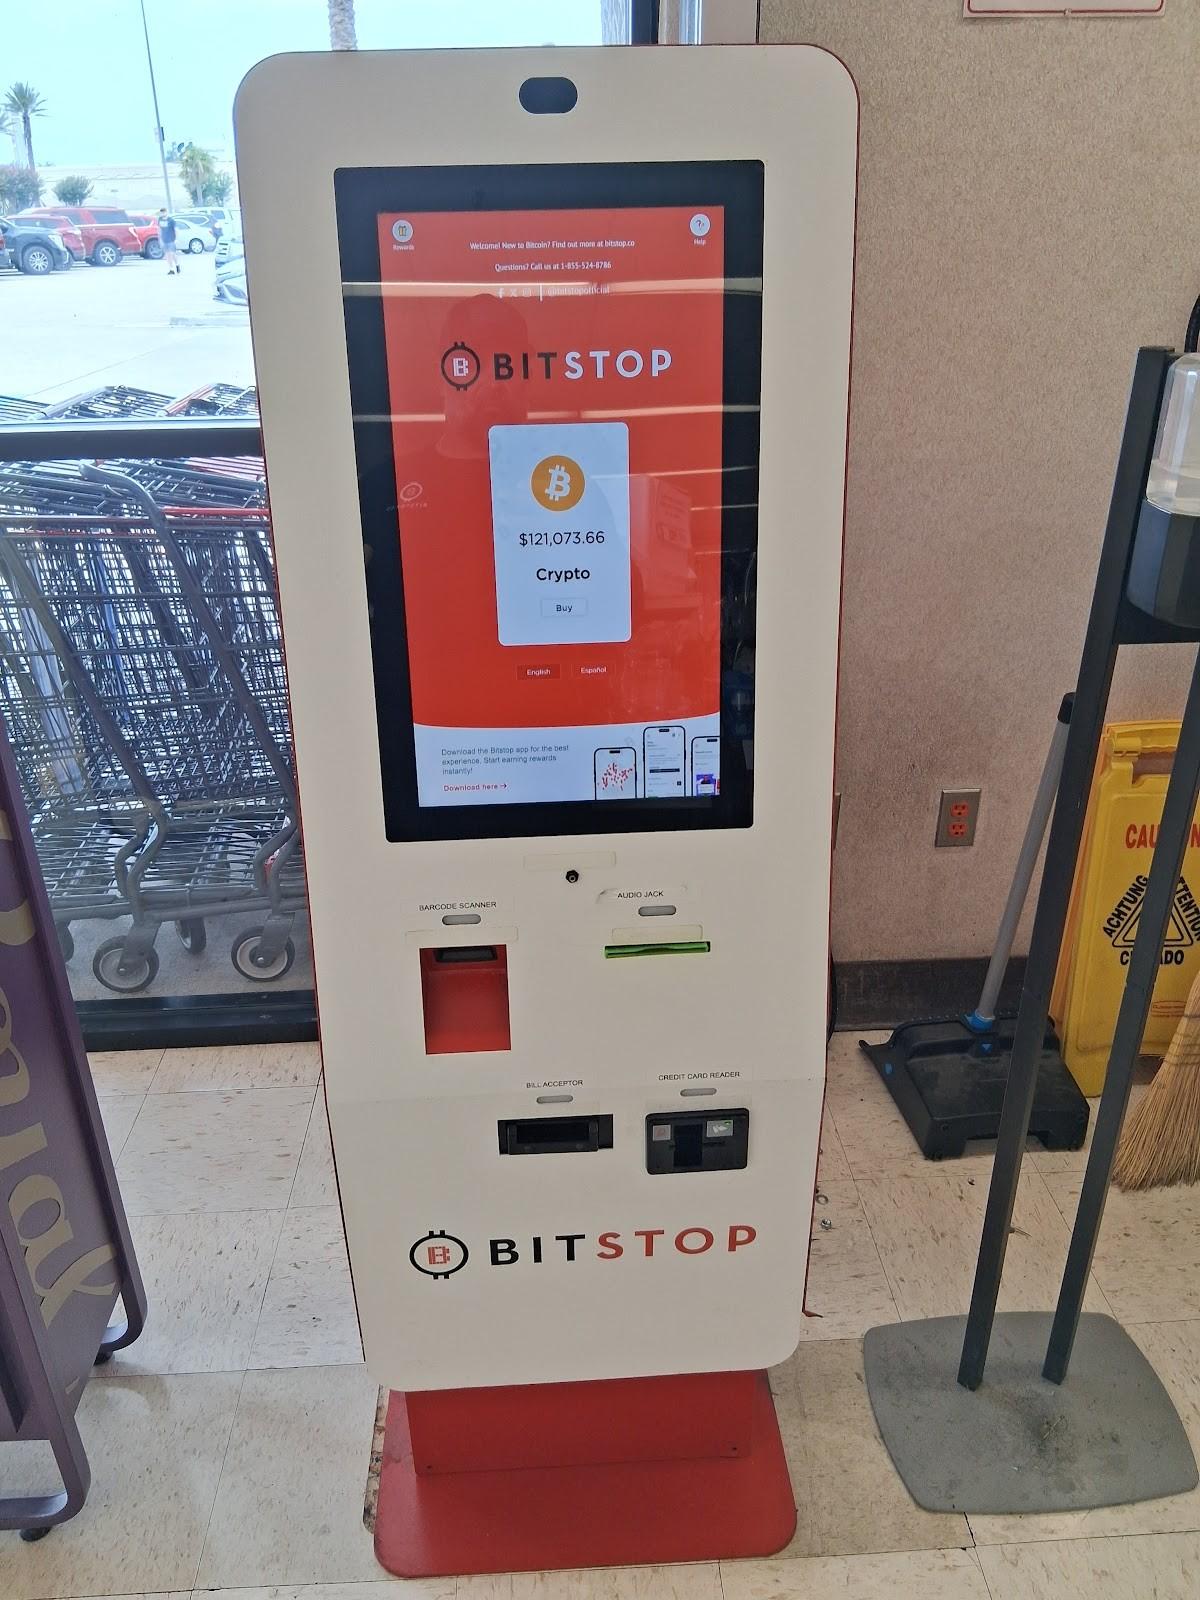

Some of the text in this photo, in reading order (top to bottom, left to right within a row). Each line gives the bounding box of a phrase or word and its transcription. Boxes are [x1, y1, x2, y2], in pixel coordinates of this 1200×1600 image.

[470, 241, 500, 250] Welcome!
[501, 241, 516, 250] New
[525, 240, 550, 249] Bitcoin?
[552, 240, 566, 249] Find
[567, 240, 578, 248] out
[579, 240, 596, 248] more
[596, 240, 603, 248] at
[604, 239, 635, 249] bitstop.co
[494, 261, 612, 272] Questions? Call us at 1-855-524-8786
[494, 349, 672, 381] BITSTOP
[519, 531, 605, 547] $121,073.66
[536, 567, 591, 583] Crypto
[555, 604, 573, 613] Buy
[526, 667, 551, 677] English
[580, 665, 607, 674] Español
[441, 748, 476, 756] Download
[477, 747, 489, 755] the
[490, 746, 514, 756] Bitstop
[515, 746, 529, 755] app
[541, 744, 553, 752] the
[554, 744, 569, 752] best
[483, 756, 500, 764] Start
[501, 756, 528, 764] earning
[529, 754, 557, 762] rewards
[442, 767, 473, 775] instantly!
[443, 782, 498, 792] Download here
[617, 890, 665, 899] AUDIO JACK
[419, 901, 497, 911] BARCODE SCANNER
[1102, 874, 1148, 938] ACHTUNG
[658, 1071, 741, 1081] CREDIT CARD READER
[526, 1079, 584, 1089] BILL ACCEPTOR
[489, 1225, 757, 1265] BITSTOP
